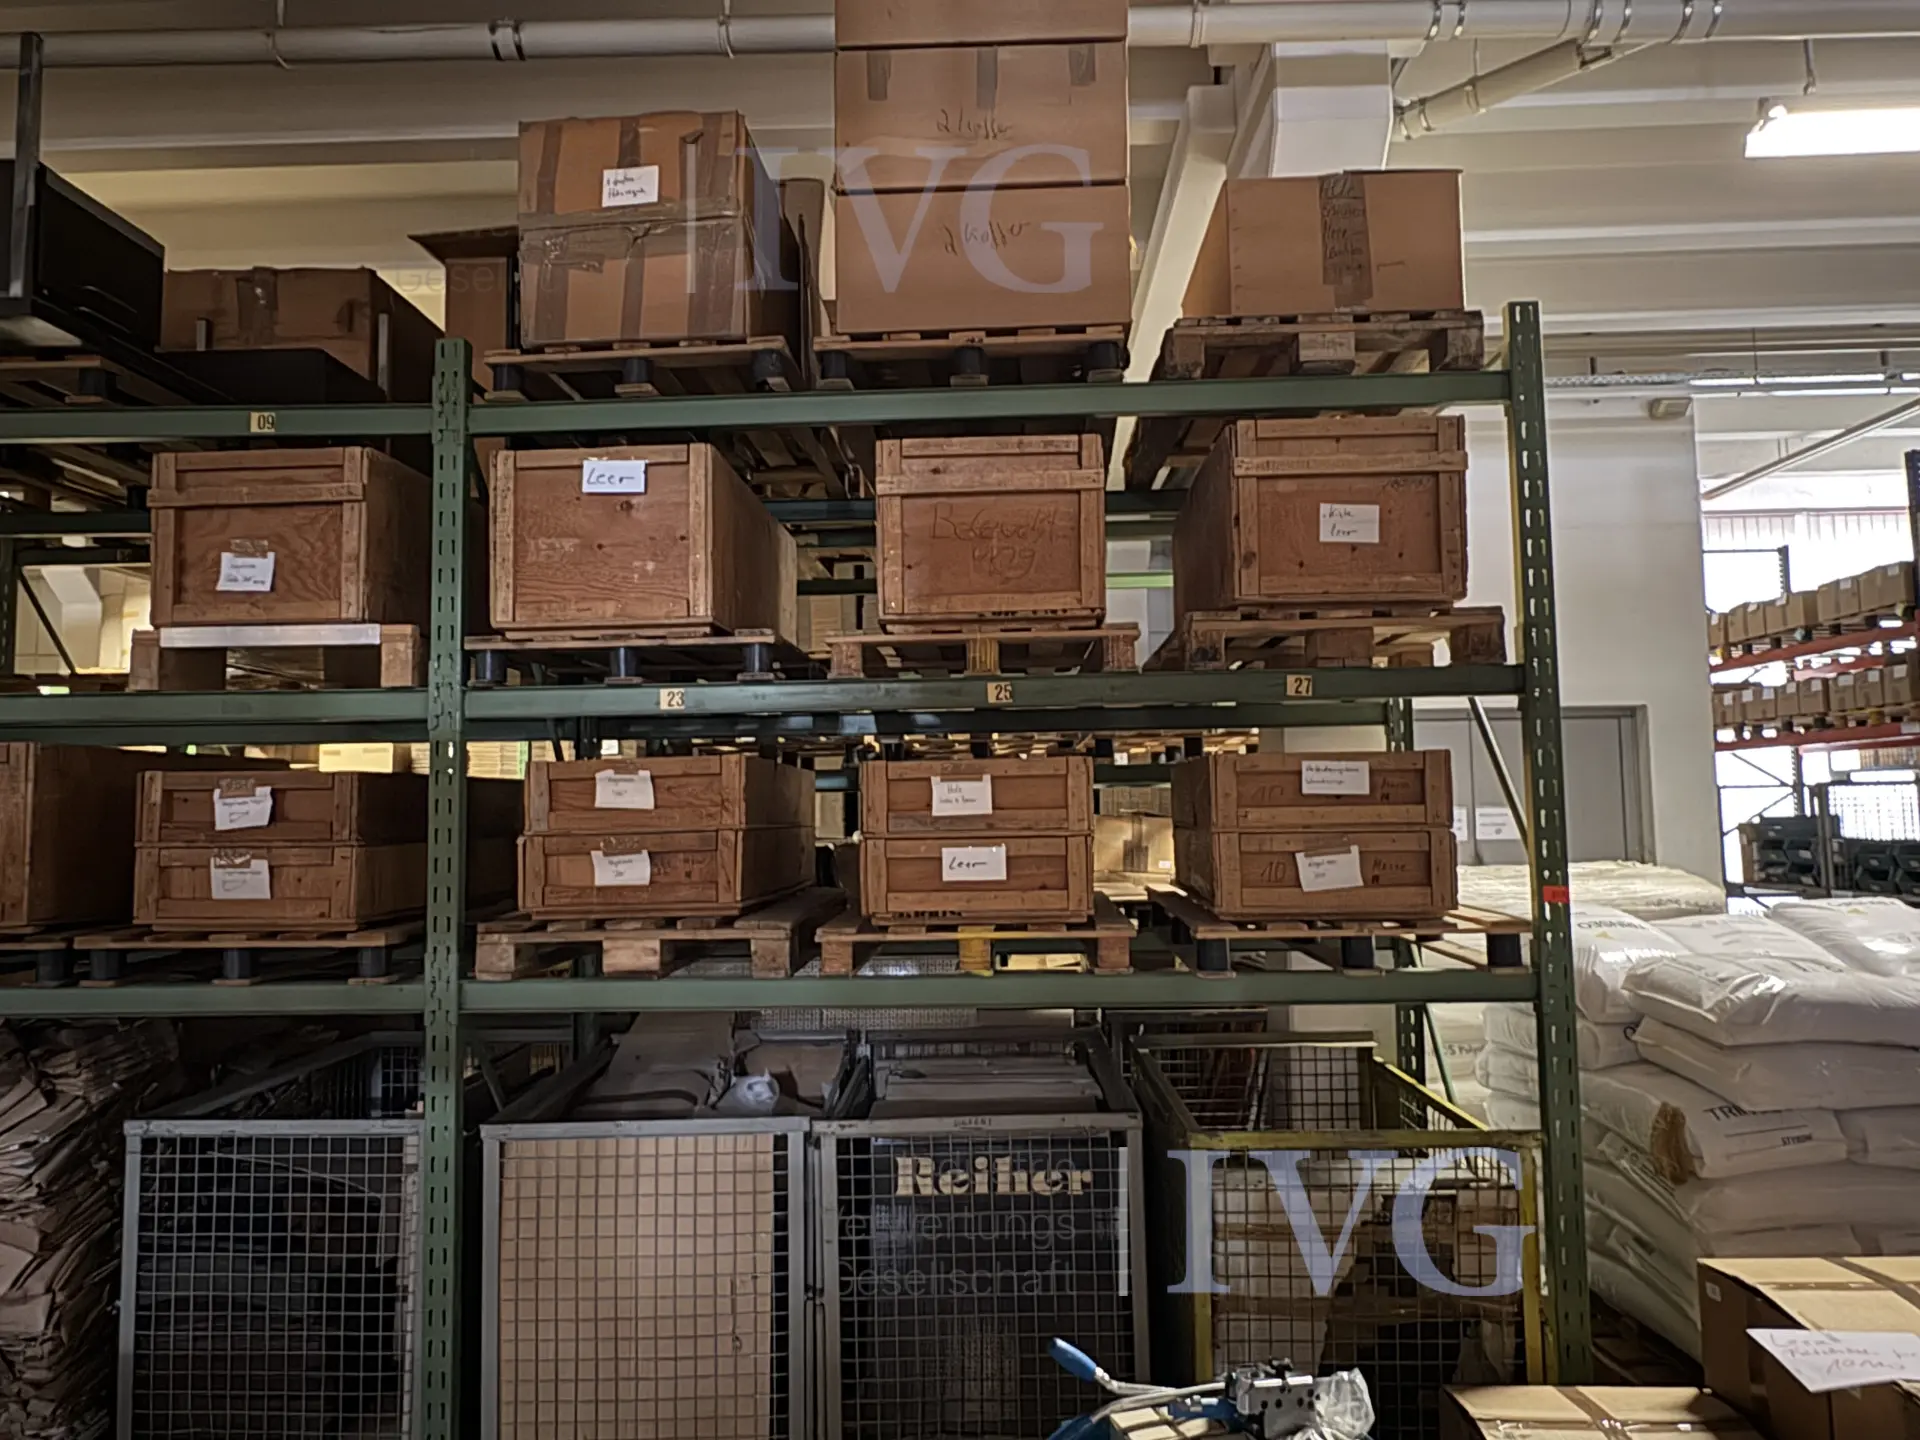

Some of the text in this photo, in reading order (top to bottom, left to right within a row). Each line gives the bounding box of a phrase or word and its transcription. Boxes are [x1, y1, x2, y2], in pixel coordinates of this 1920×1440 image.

[257, 414, 275, 430] 09
[587, 467, 635, 485] Leer
[995, 684, 1013, 701] 25
[1294, 677, 1312, 695] 27
[667, 691, 685, 707] 23
[948, 856, 987, 870] Leer
